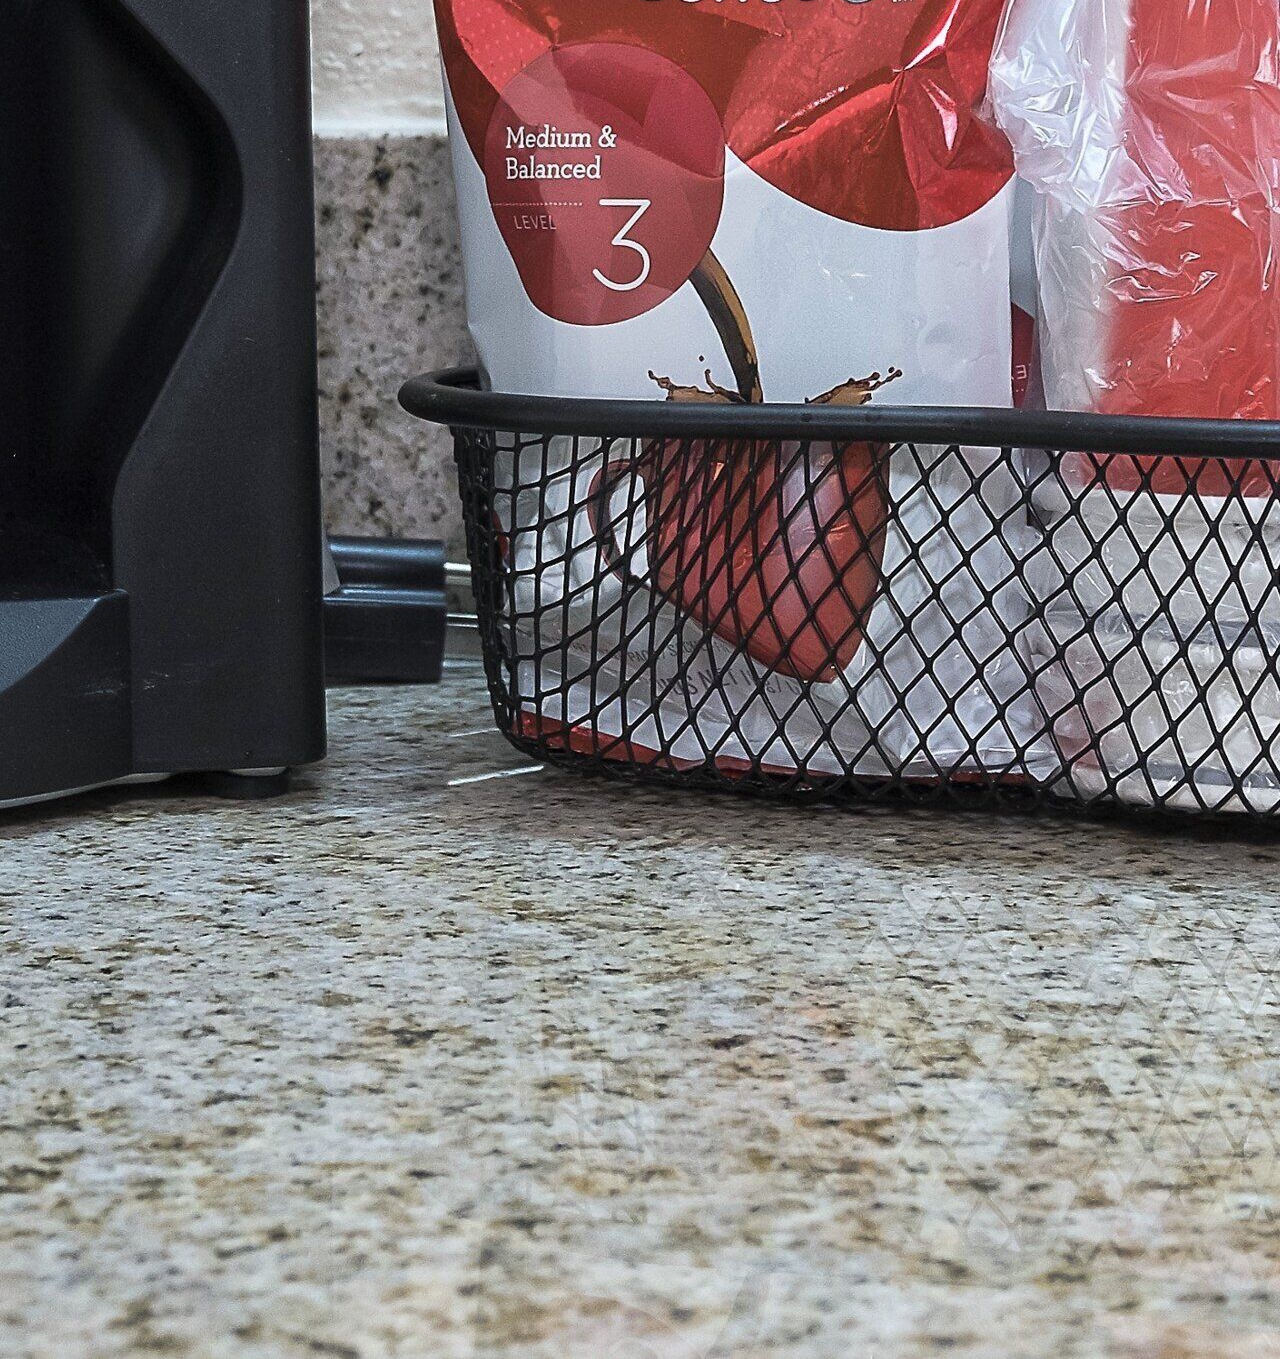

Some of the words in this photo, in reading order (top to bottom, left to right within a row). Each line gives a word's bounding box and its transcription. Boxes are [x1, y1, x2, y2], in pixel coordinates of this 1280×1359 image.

[506, 123, 592, 149] Medium
[598, 124, 618, 148] &
[505, 155, 602, 180] Balanced
[513, 214, 557, 230] LEVEL
[592, 198, 651, 292] 3
